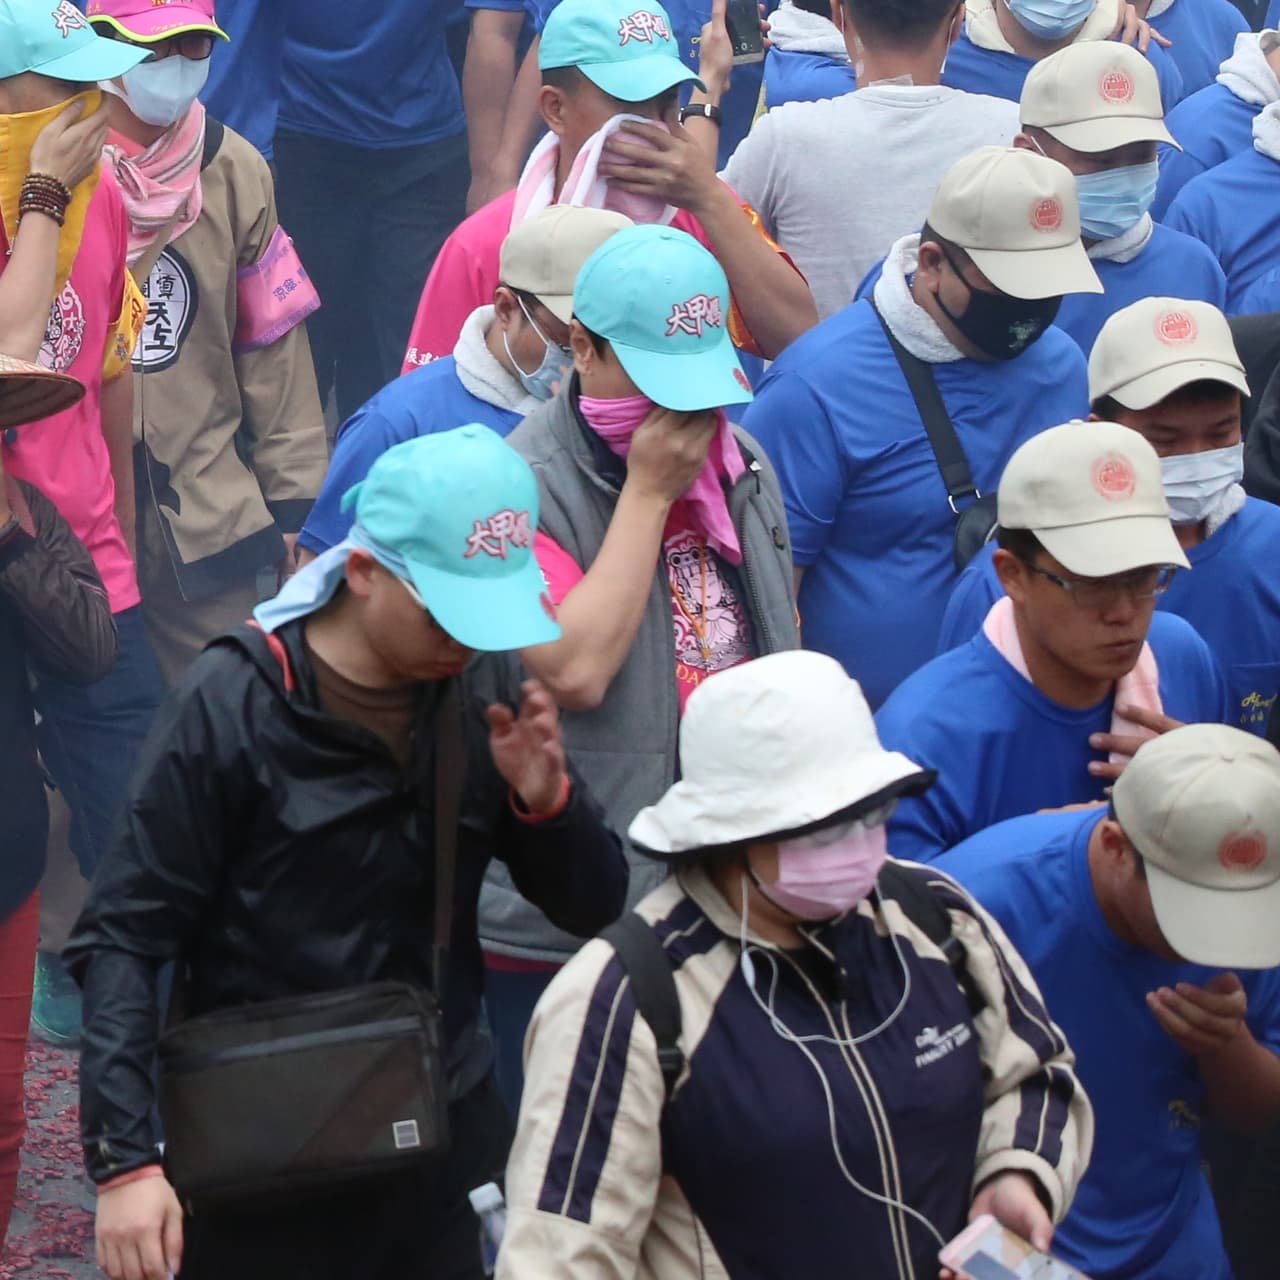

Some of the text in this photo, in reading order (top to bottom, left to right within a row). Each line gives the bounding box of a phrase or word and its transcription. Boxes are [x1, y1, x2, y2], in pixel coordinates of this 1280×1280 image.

[617, 10, 671, 47] 大甲媽
[664, 292, 723, 339] 大甲媽
[463, 508, 531, 562] 大甲媽
